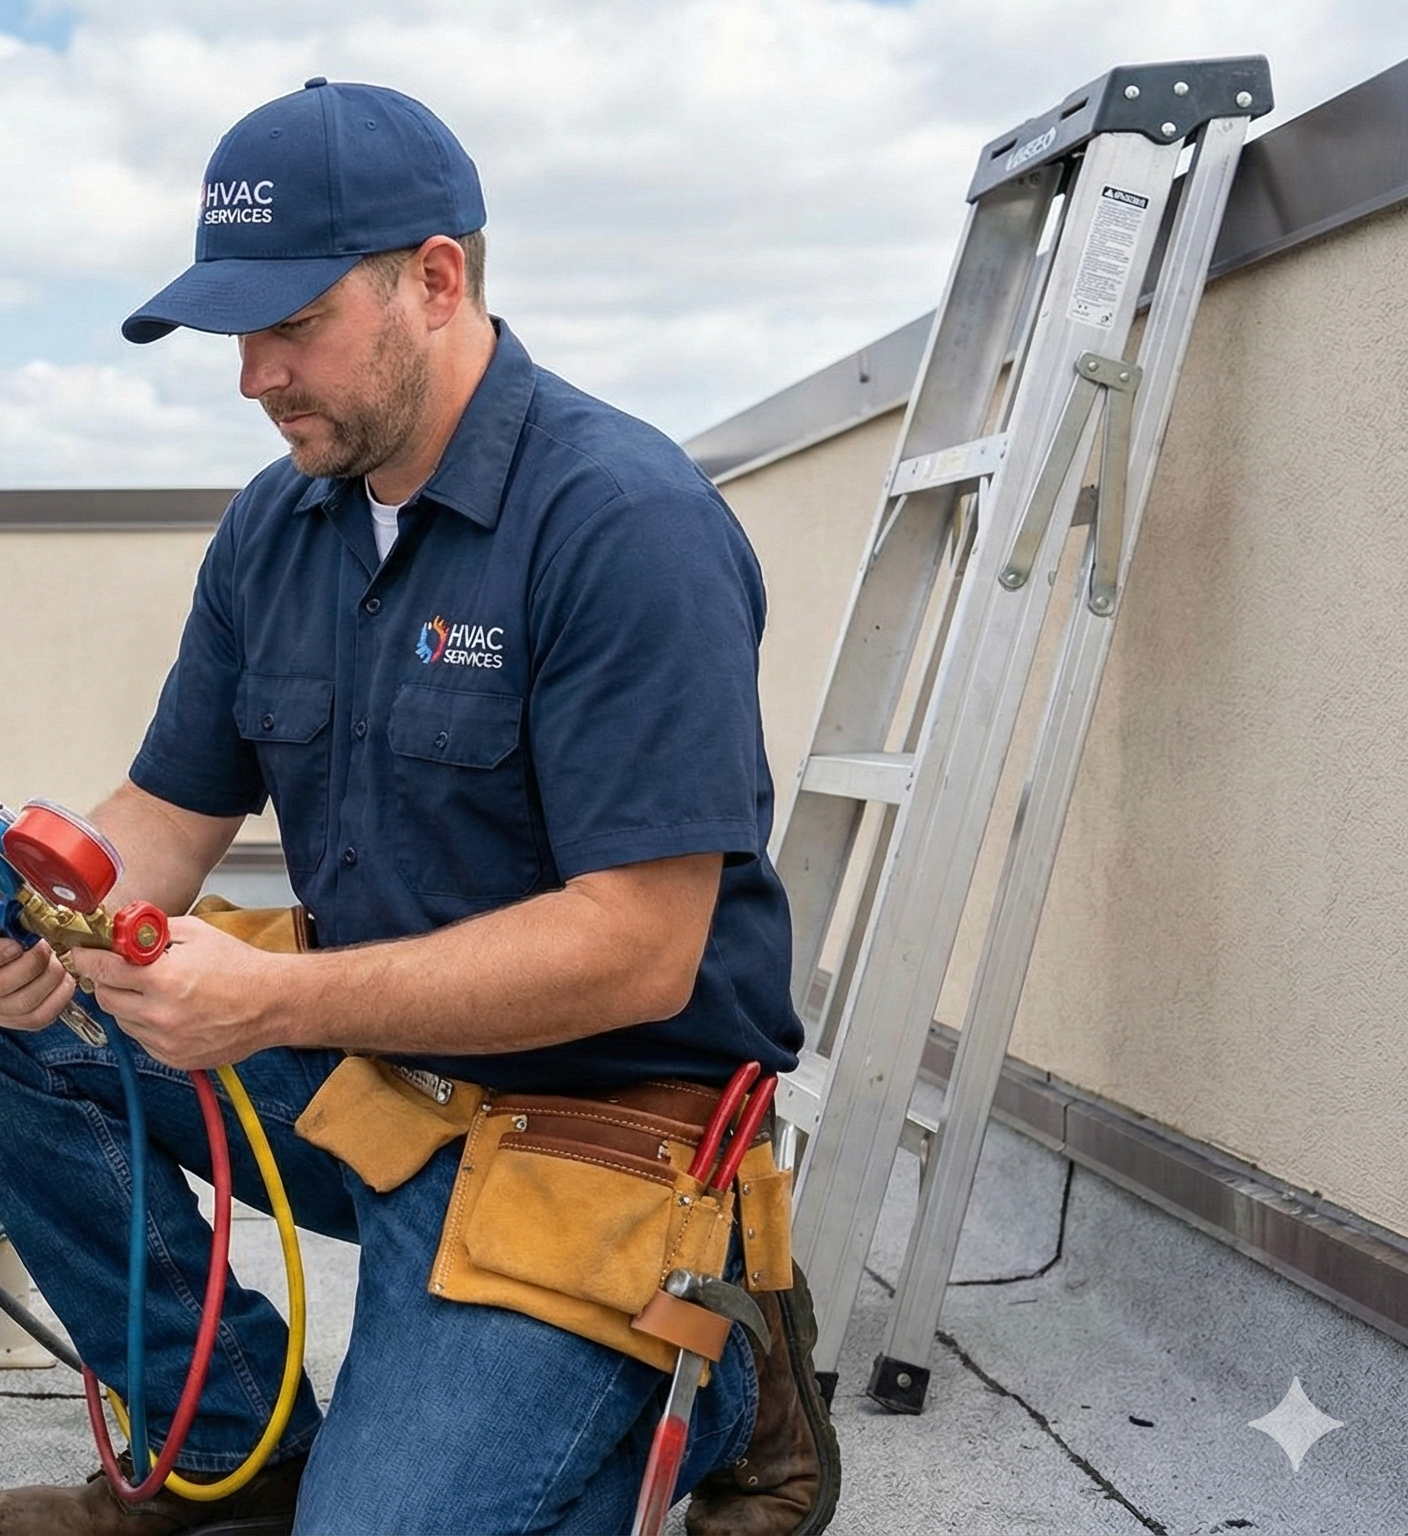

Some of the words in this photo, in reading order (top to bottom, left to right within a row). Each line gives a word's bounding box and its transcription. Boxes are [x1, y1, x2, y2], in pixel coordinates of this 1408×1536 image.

[206, 180, 274, 207] HVAC
[204, 208, 272, 224] SERVICES
[447, 624, 504, 650] HVAC
[443, 649, 503, 668] SERVICES
